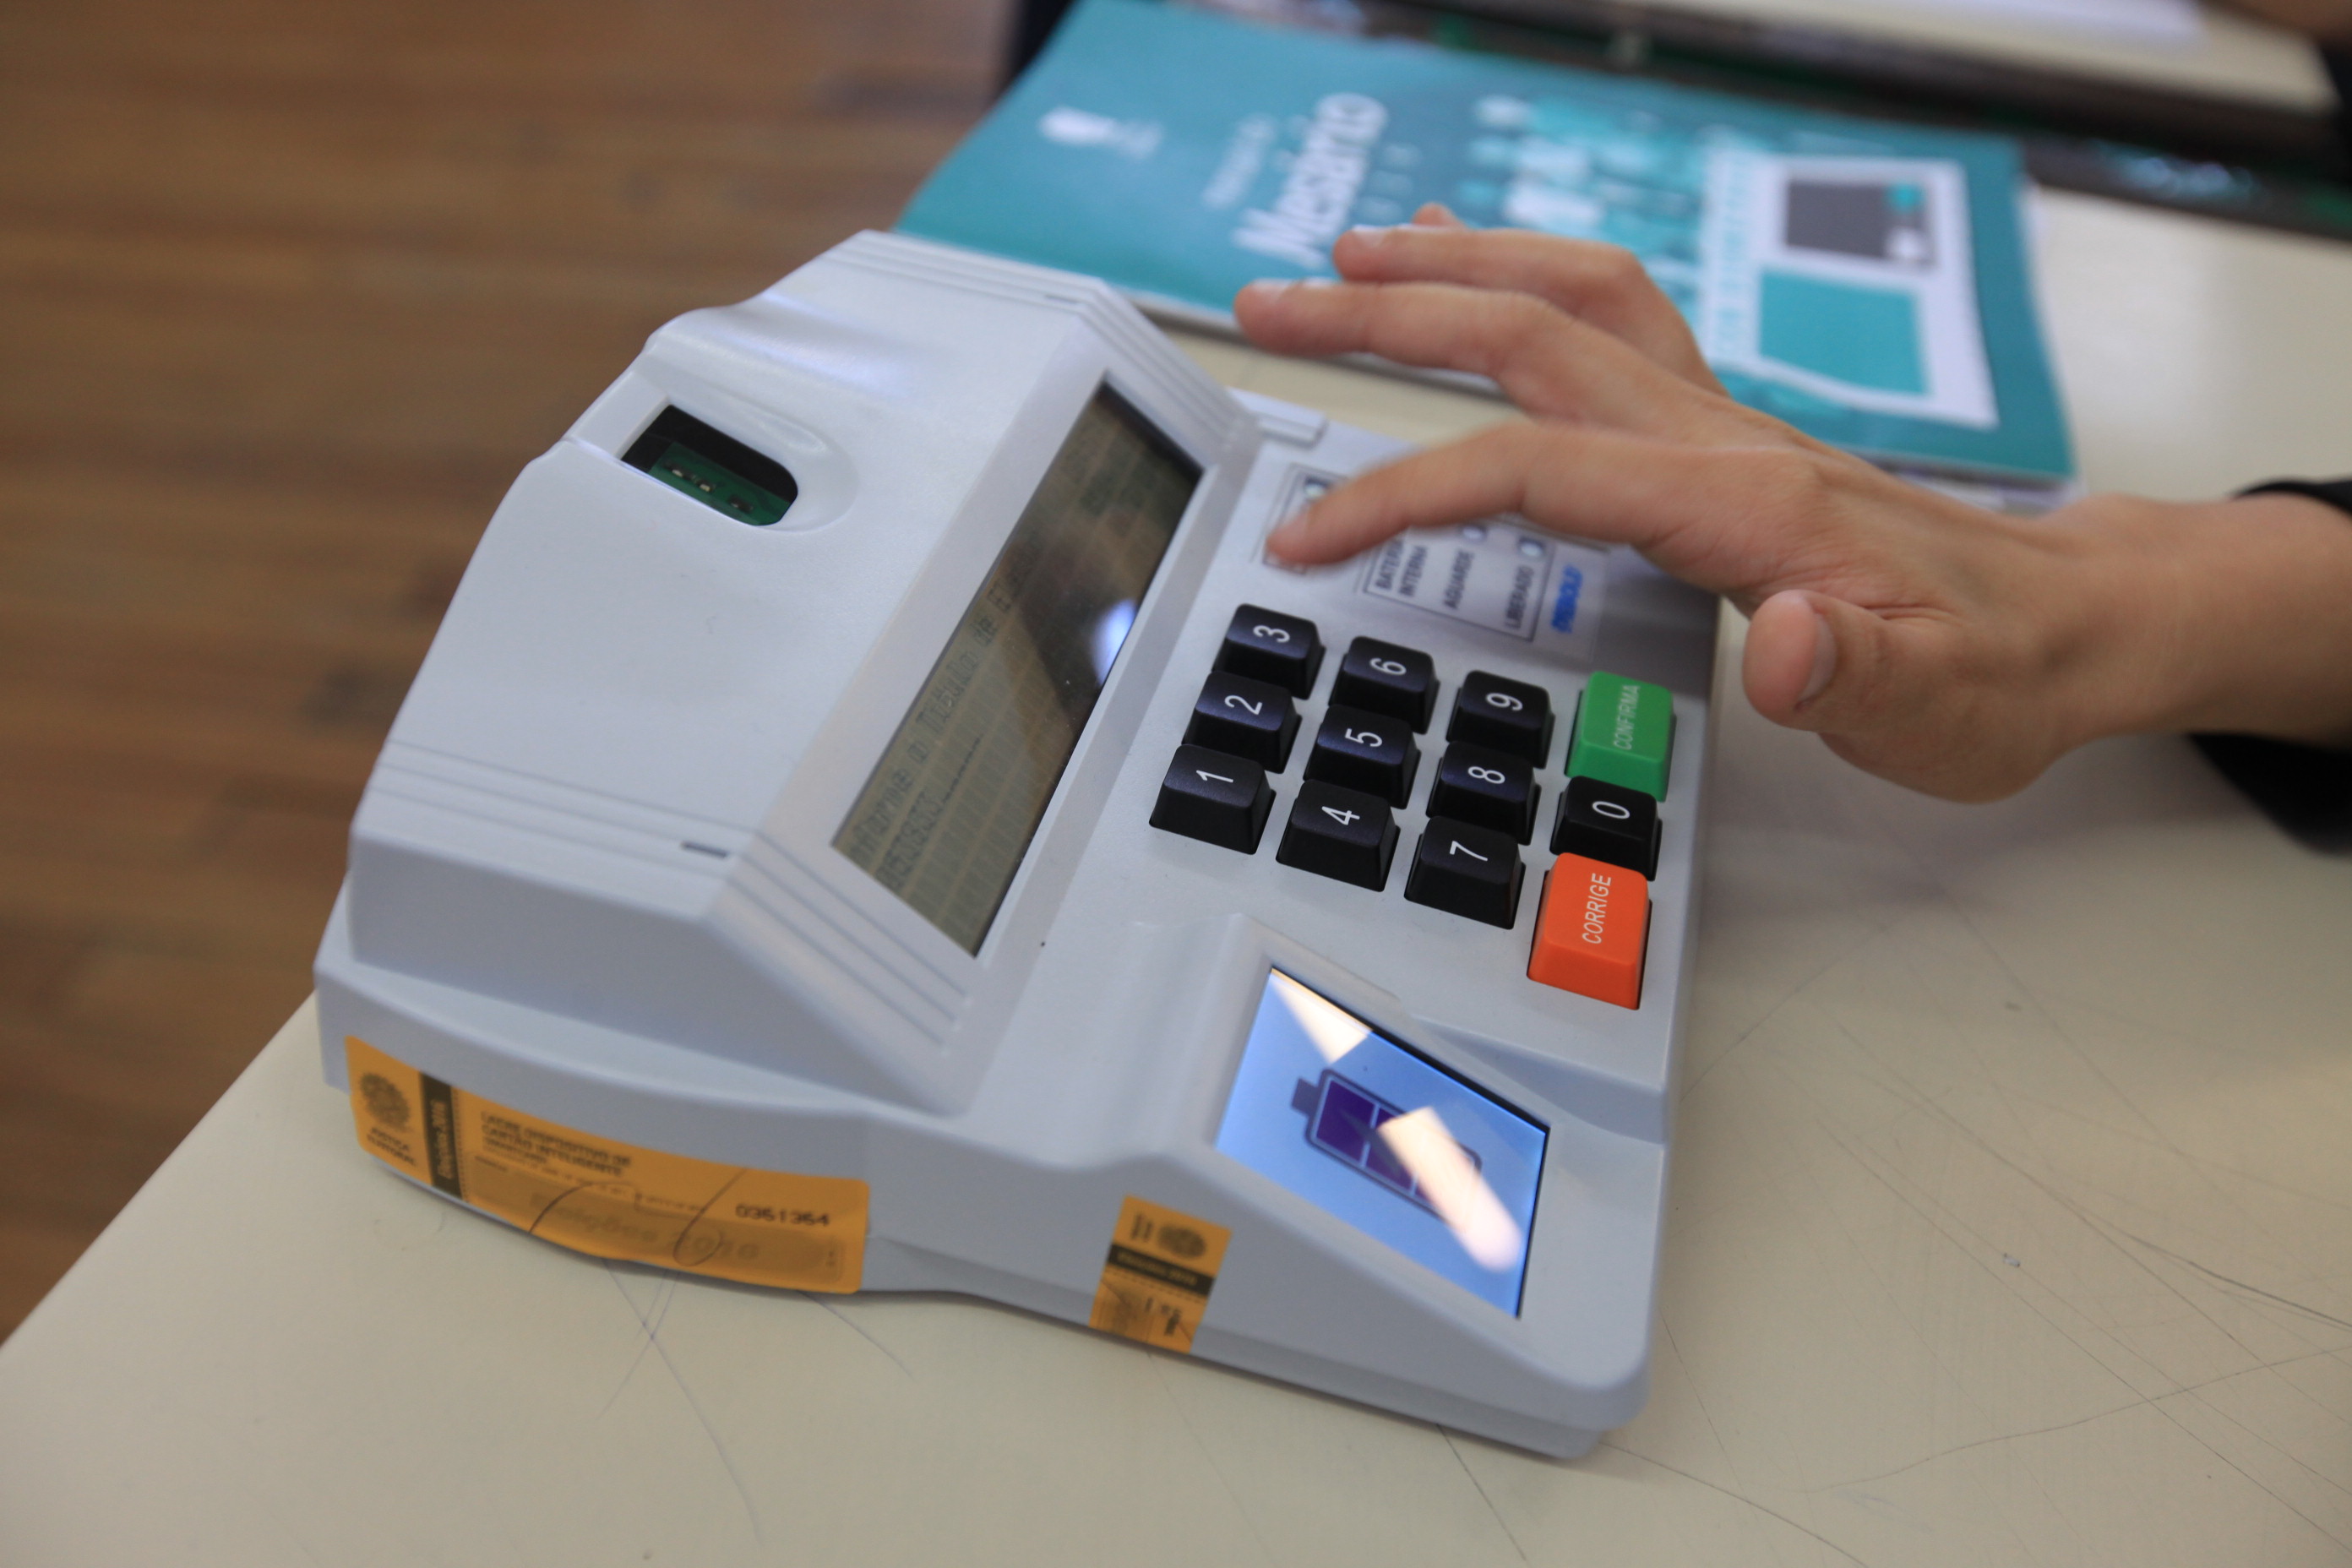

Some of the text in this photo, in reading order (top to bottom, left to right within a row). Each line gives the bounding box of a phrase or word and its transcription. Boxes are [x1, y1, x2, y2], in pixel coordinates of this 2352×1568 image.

[1443, 549, 1476, 609] AGUARDE
[1505, 565, 1535, 629] LIBERADO
[1253, 624, 1291, 644] 3
[1370, 657, 1407, 676] 6
[1224, 694, 1263, 716] 2
[1486, 692, 1523, 712] 9
[1612, 684, 1642, 750] CONFIRMA
[1345, 728, 1383, 749] 5
[1195, 769, 1234, 784] 1
[1467, 765, 1505, 786] 8
[1321, 803, 1360, 825] 4
[1592, 801, 1631, 820] 0
[1450, 840, 1489, 863] 7
[1582, 873, 1612, 945] CORRIGE
